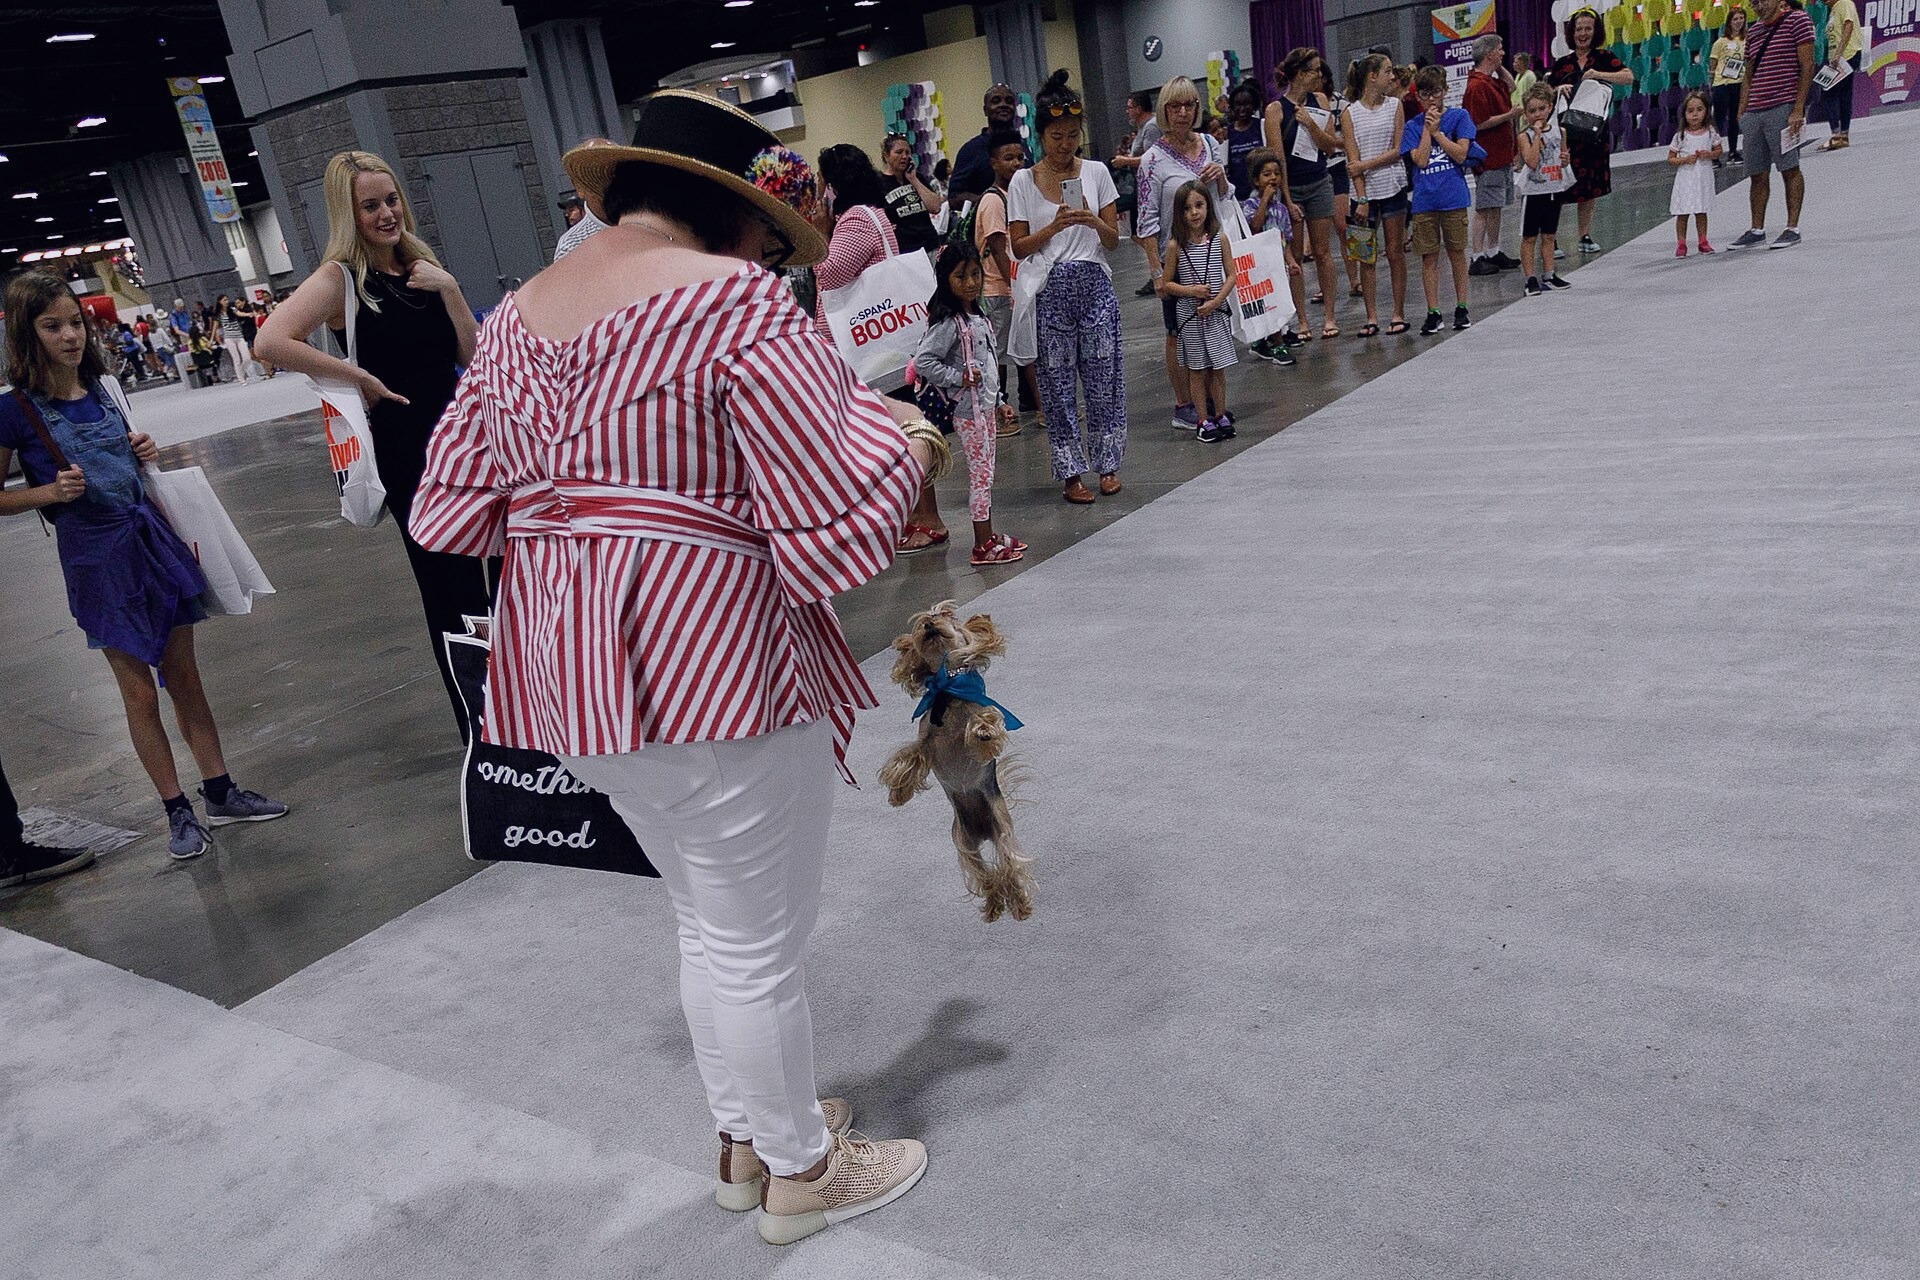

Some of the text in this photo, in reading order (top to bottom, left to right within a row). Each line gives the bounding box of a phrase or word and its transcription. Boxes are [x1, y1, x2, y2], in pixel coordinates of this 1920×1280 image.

[1883, 24, 1914, 36] STAGE
[197, 160, 227, 182] 2019
[503, 820, 597, 848] good
